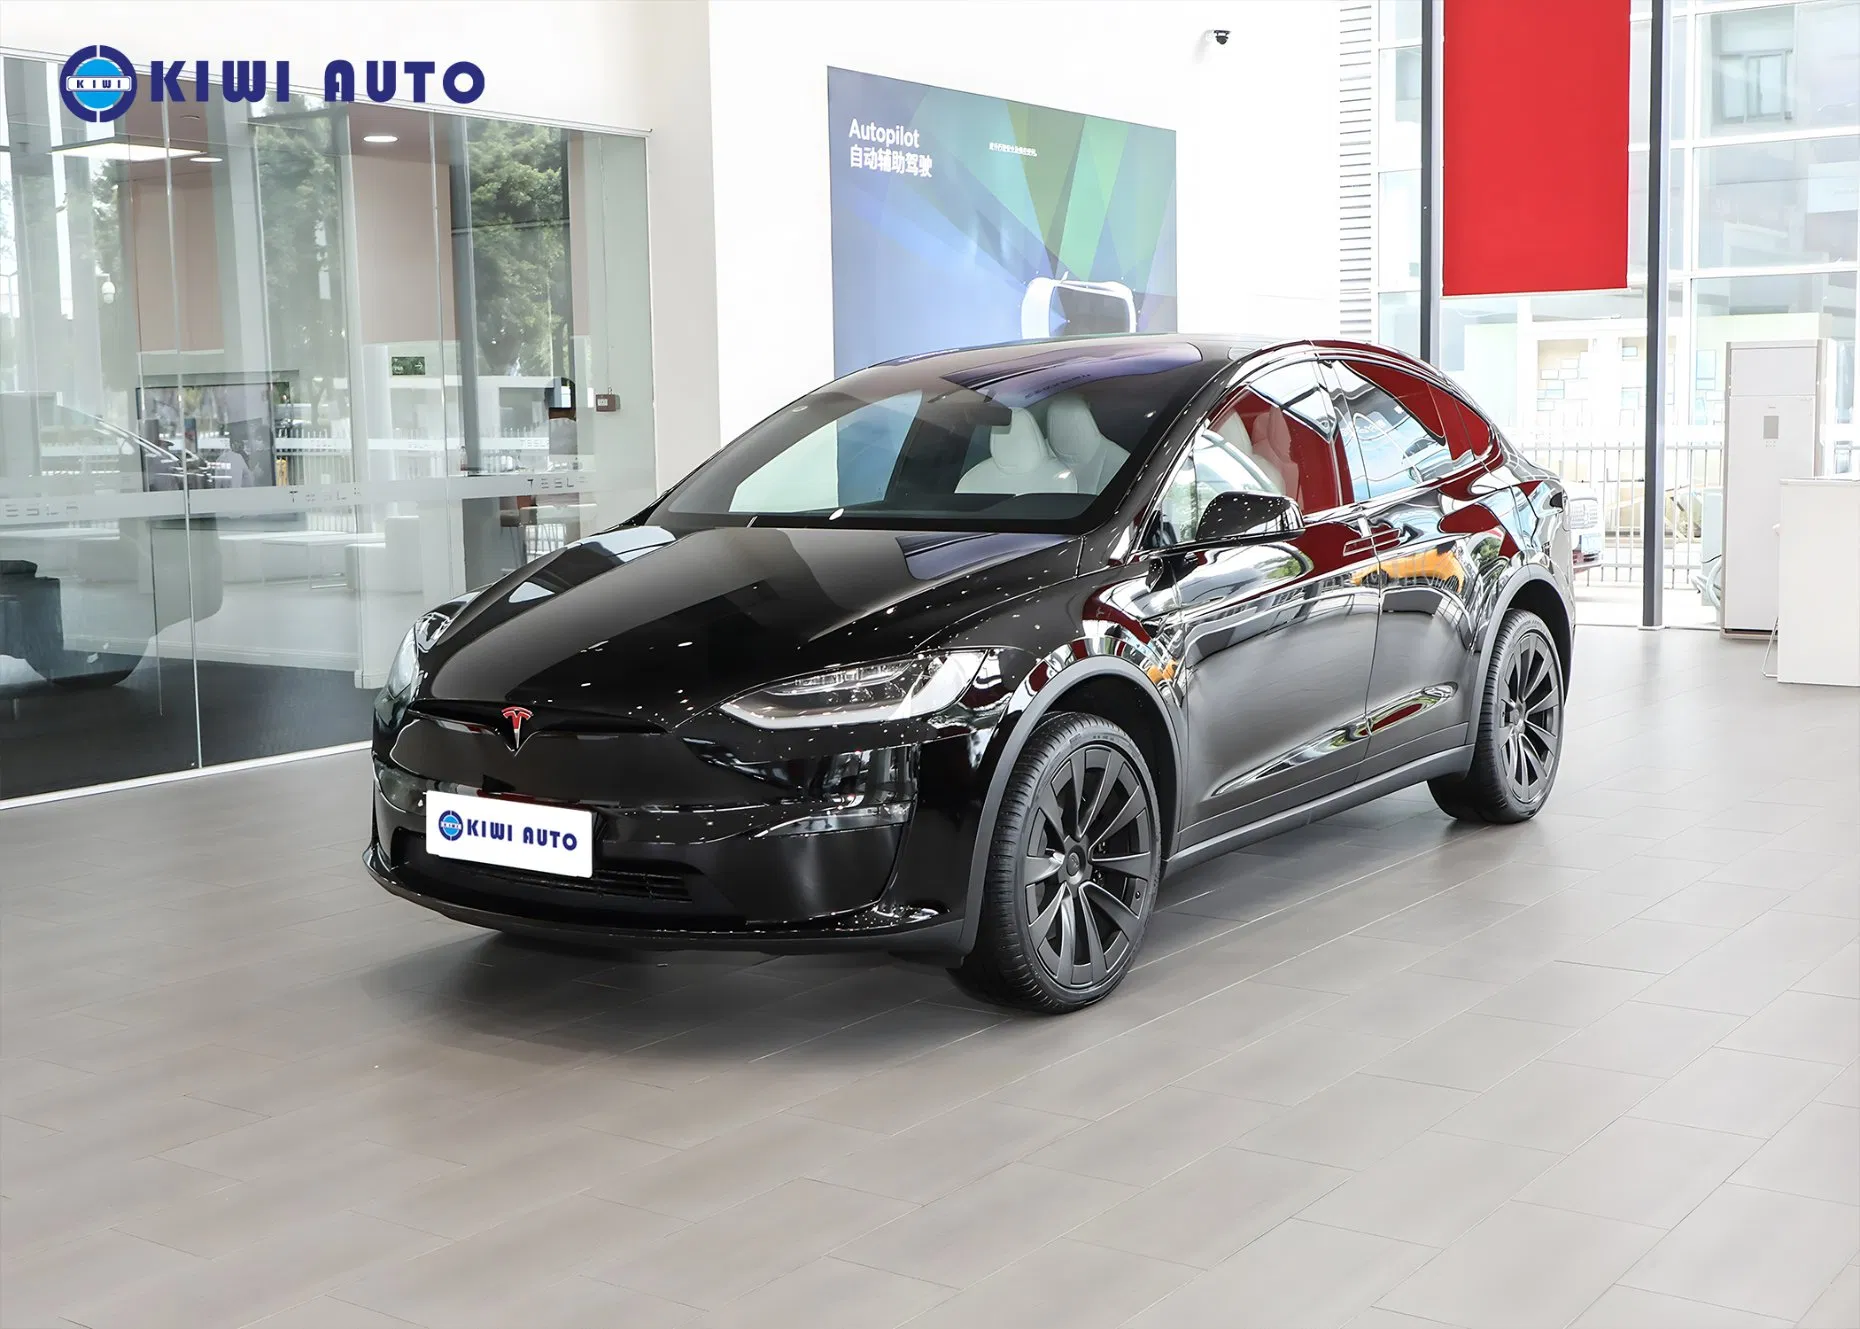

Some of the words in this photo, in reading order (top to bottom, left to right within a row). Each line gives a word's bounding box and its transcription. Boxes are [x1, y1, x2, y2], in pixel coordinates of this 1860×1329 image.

[848, 118, 920, 148] Autopilot
[850, 143, 933, 178] 自动辅助驾驶
